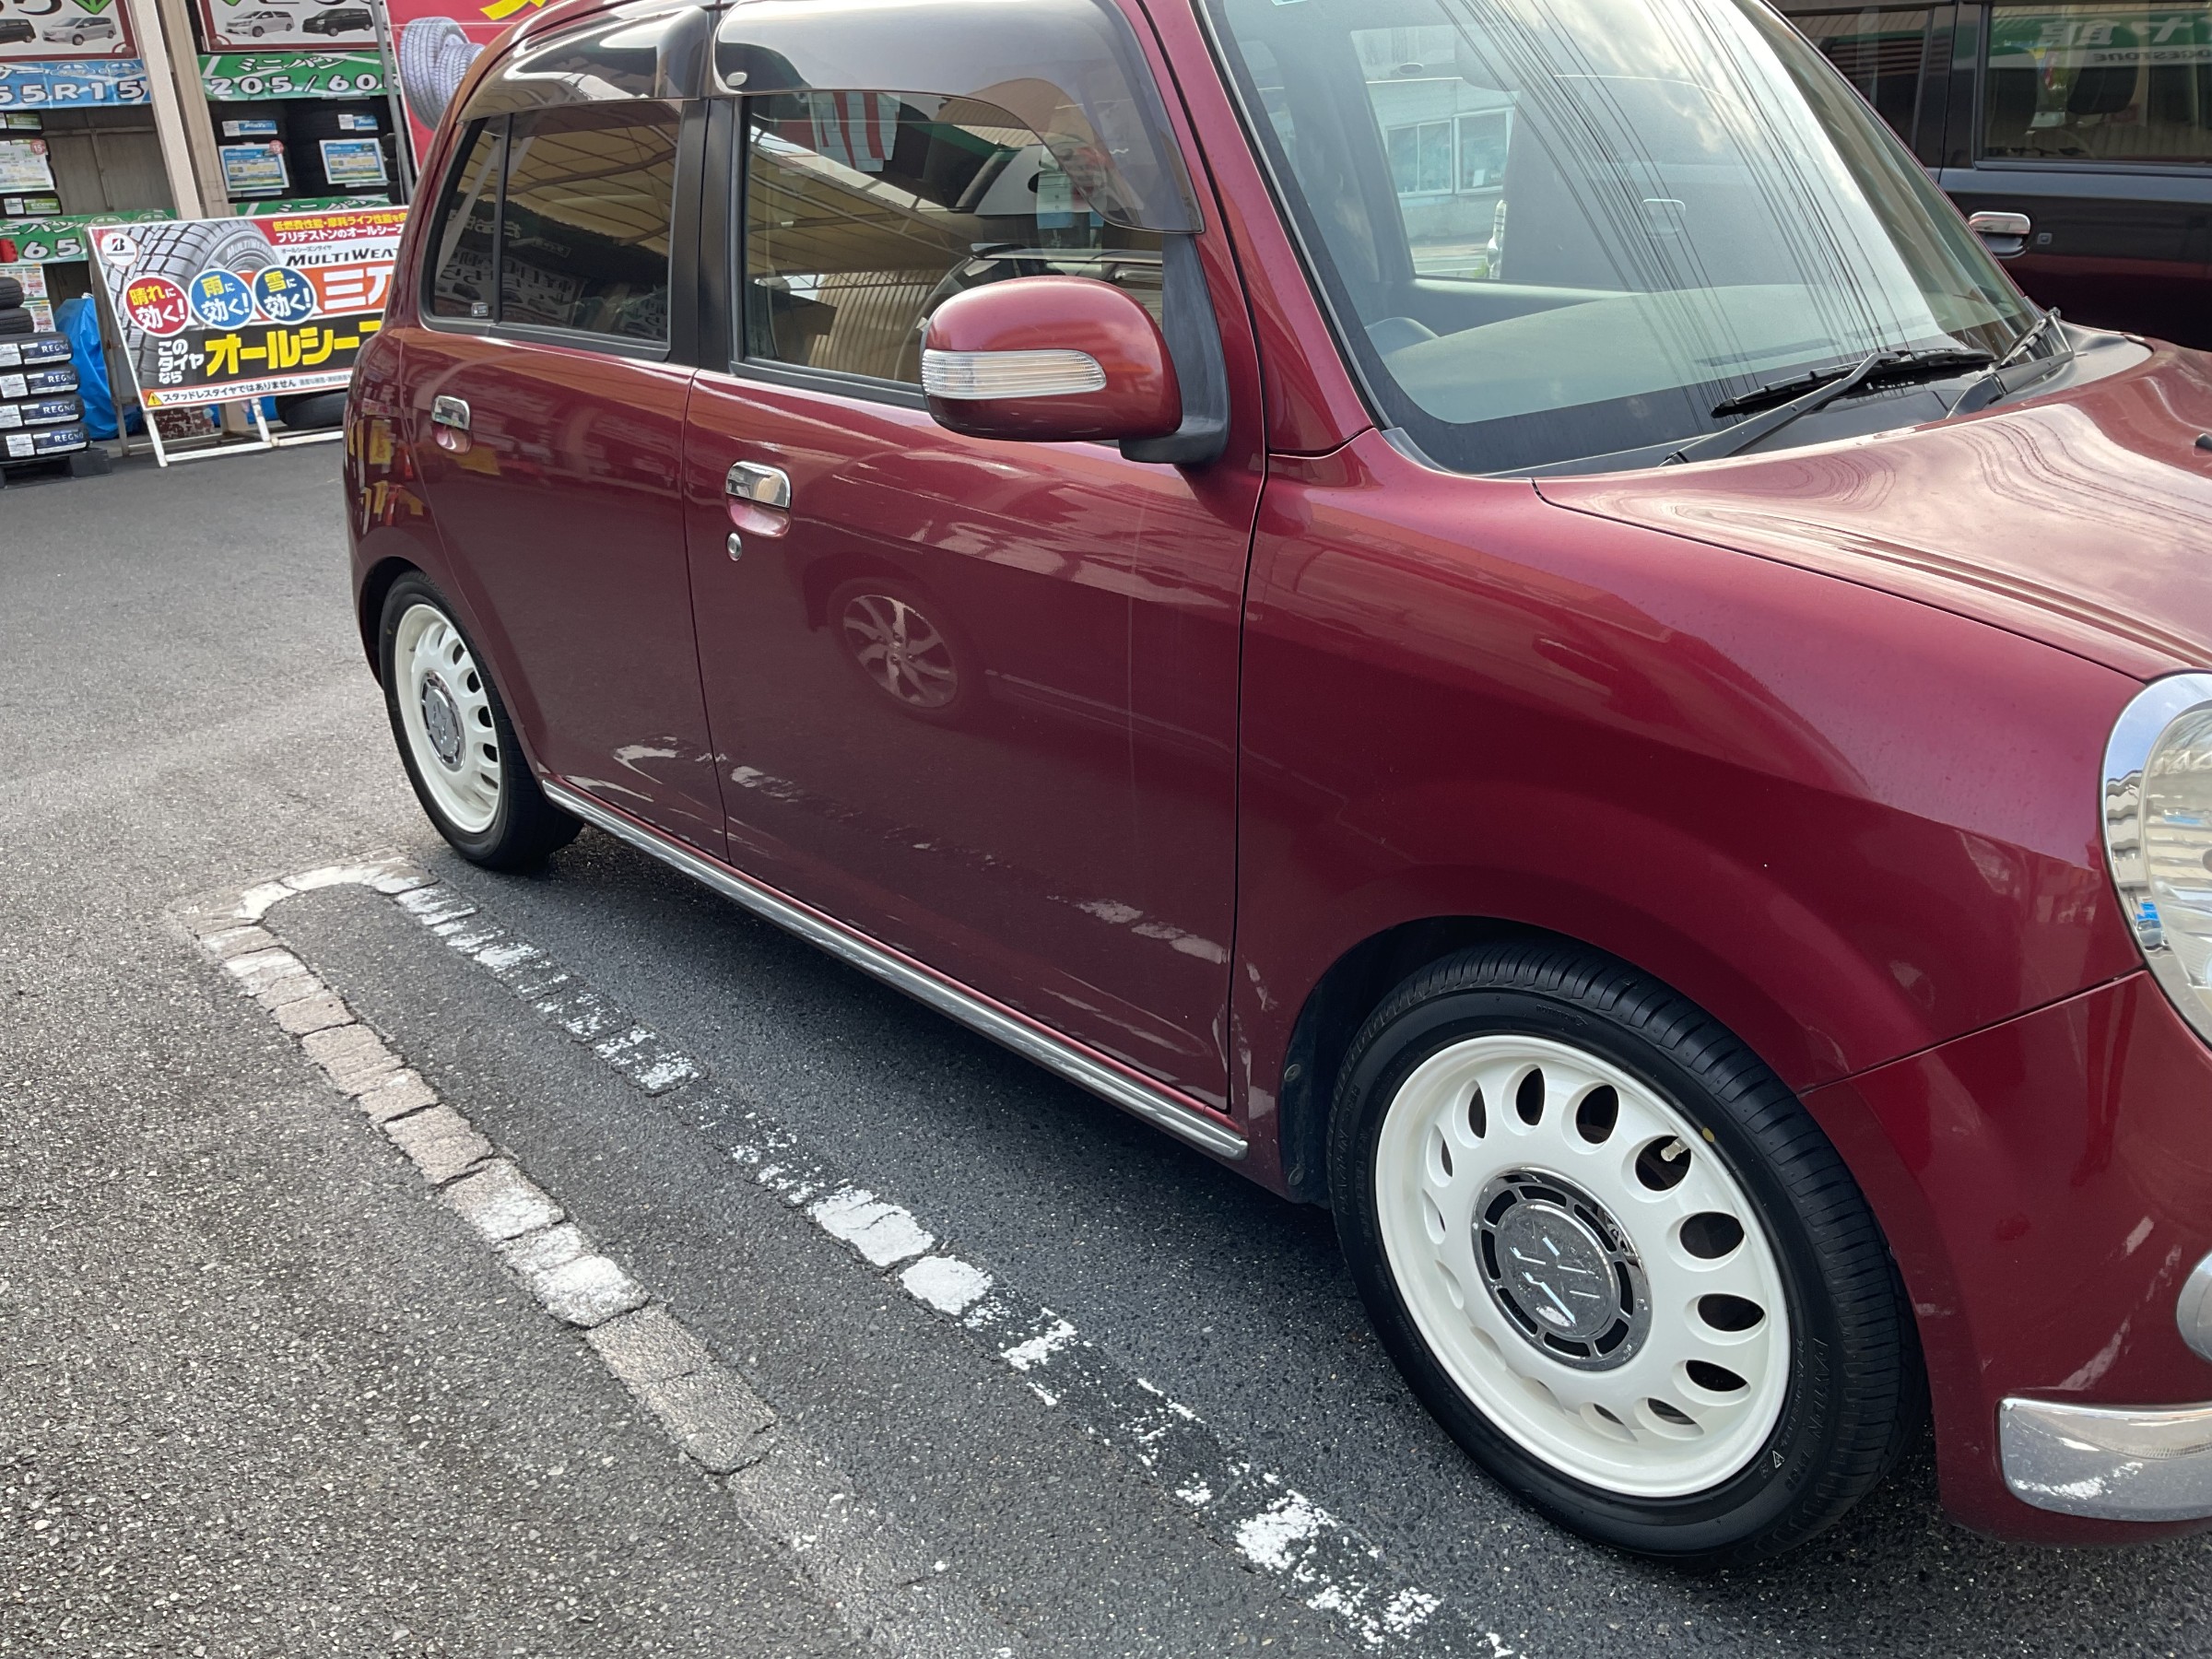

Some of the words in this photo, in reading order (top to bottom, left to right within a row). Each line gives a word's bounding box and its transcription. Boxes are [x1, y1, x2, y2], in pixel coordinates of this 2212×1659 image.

[200, 275, 235, 299] 雨に
[265, 270, 297, 292] 雪に
[128, 285, 176, 306] 晴れに
[41, 344, 69, 353] REGNO
[158, 339, 188, 356] この
[158, 353, 205, 371] タイヤ
[47, 373, 76, 383] REGNO
[158, 371, 183, 384] なら
[42, 404, 76, 415] REGNO
[53, 431, 84, 443] REGNO
